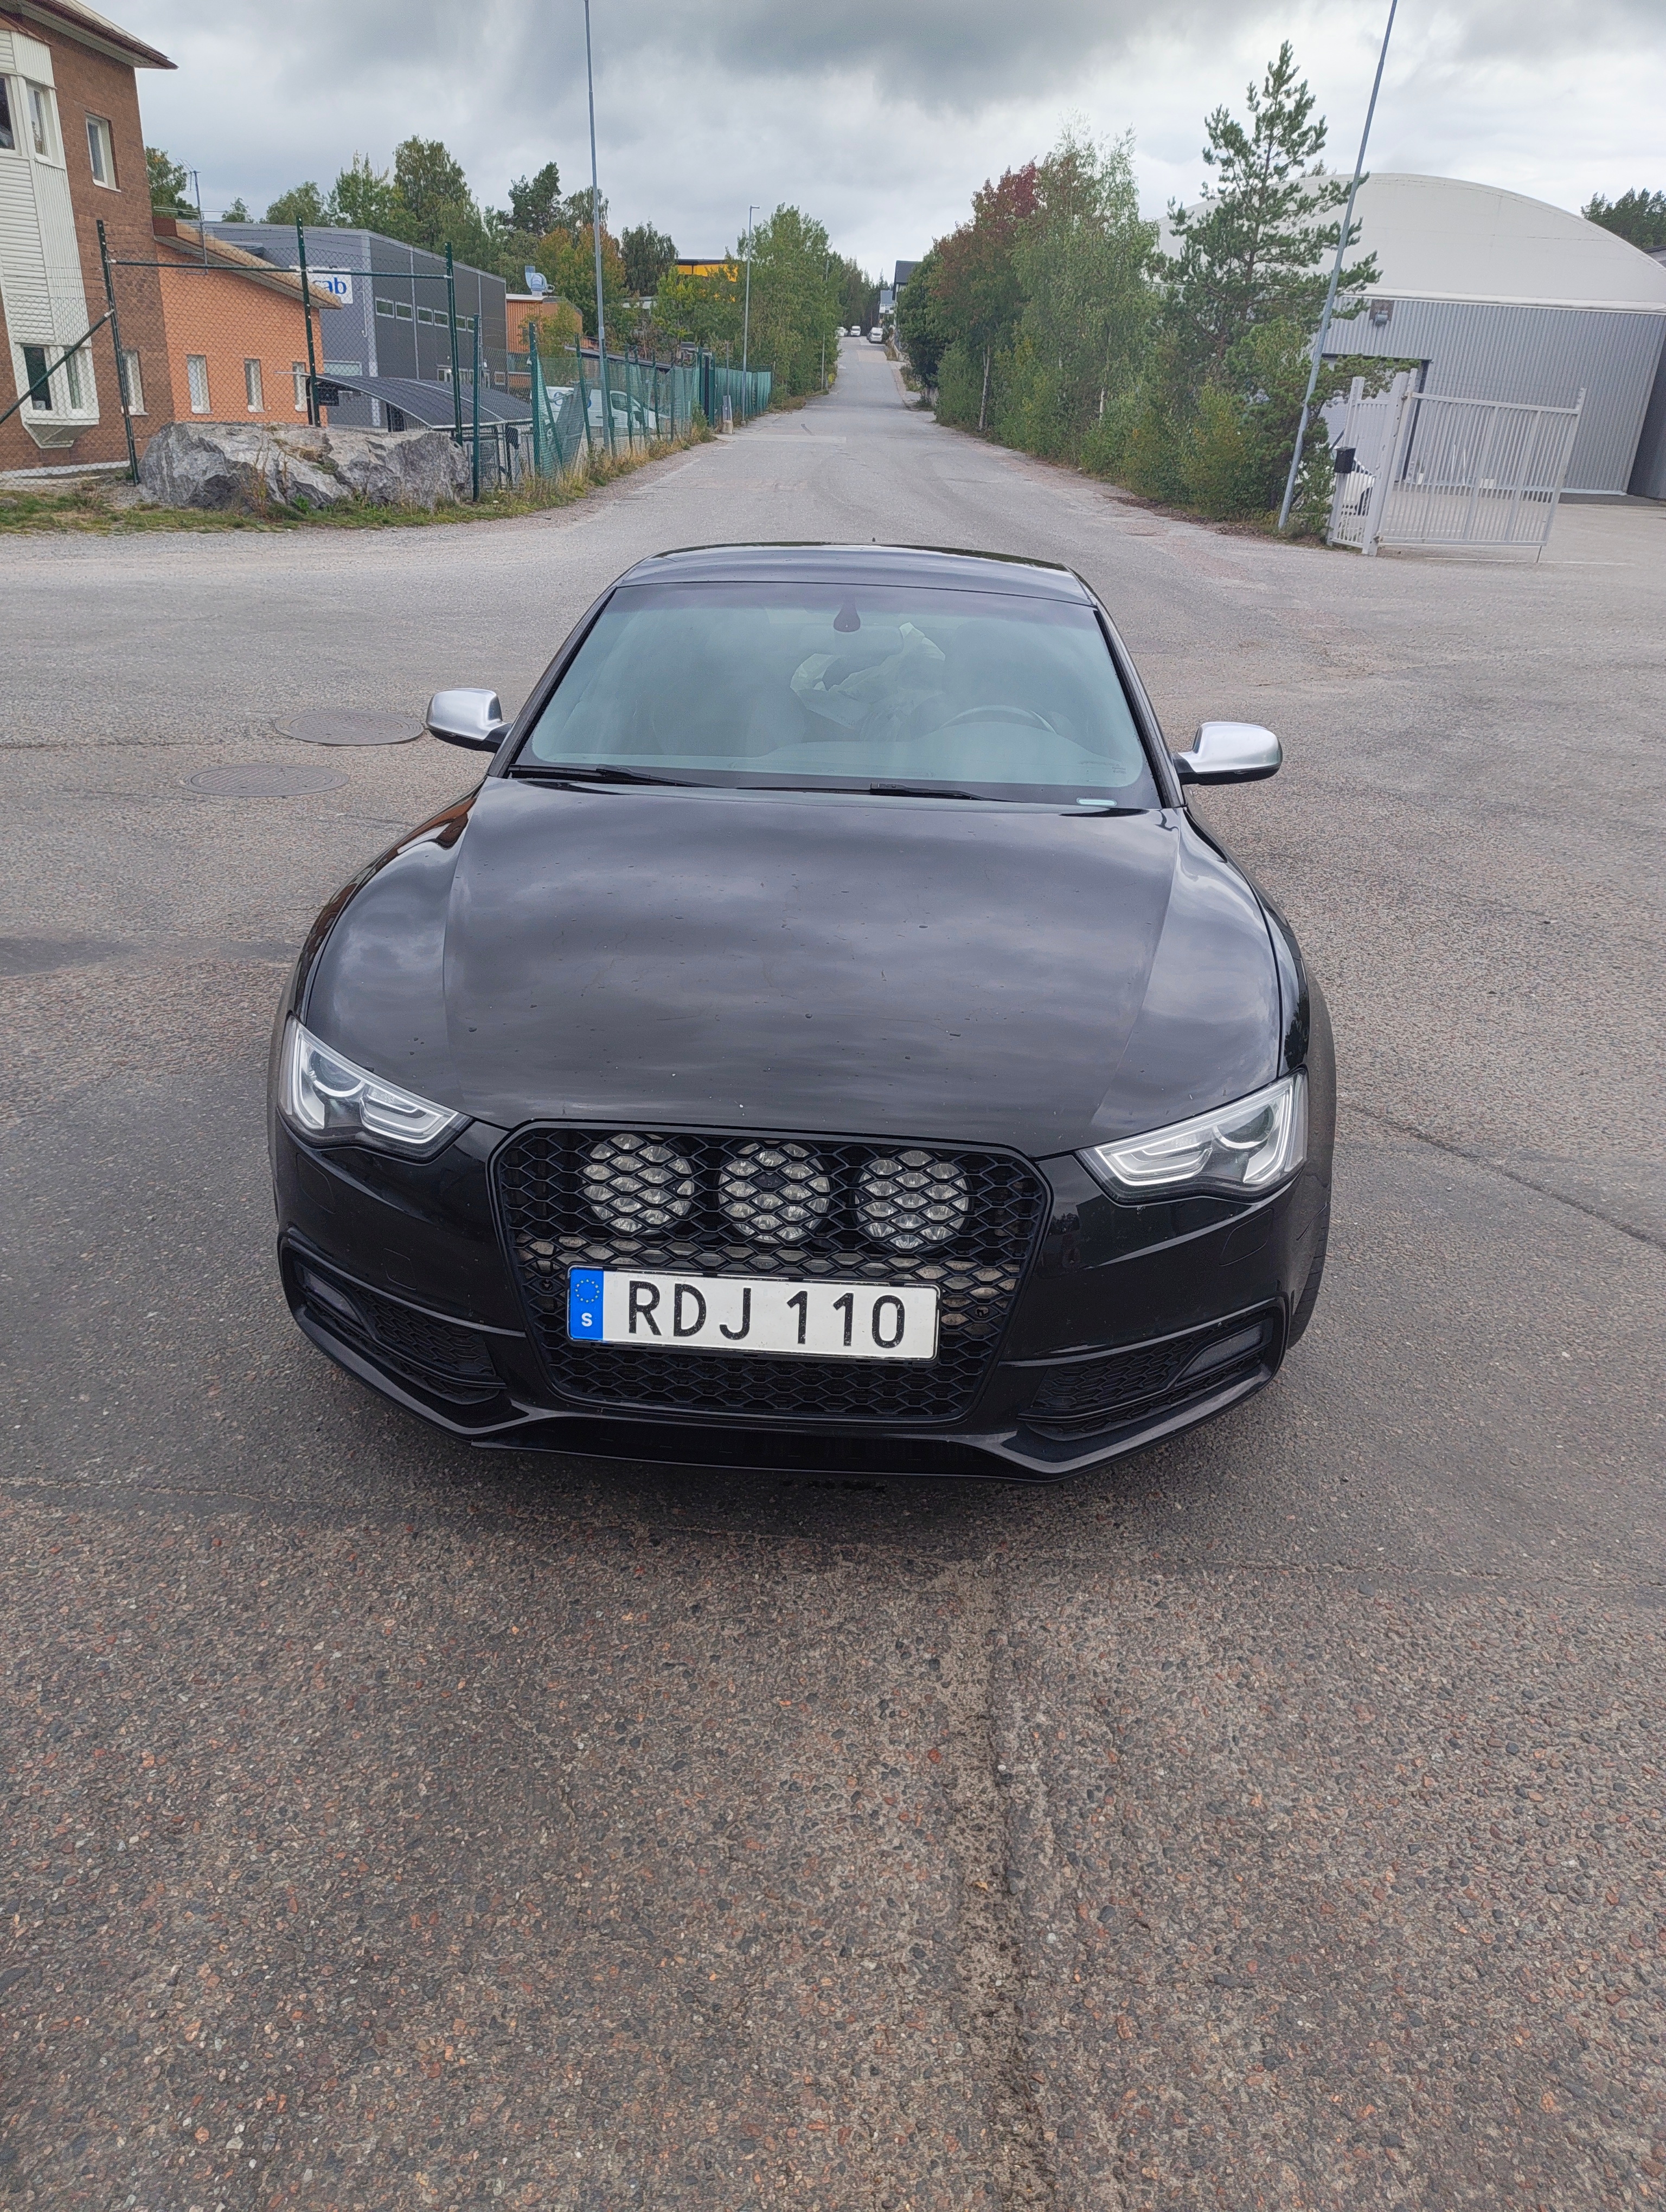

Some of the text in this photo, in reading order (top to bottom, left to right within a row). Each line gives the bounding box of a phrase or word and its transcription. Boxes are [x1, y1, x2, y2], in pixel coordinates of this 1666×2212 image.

[312, 277, 347, 294] ab
[581, 1312, 593, 1327] S
[629, 1280, 906, 1348] RDJ 110
